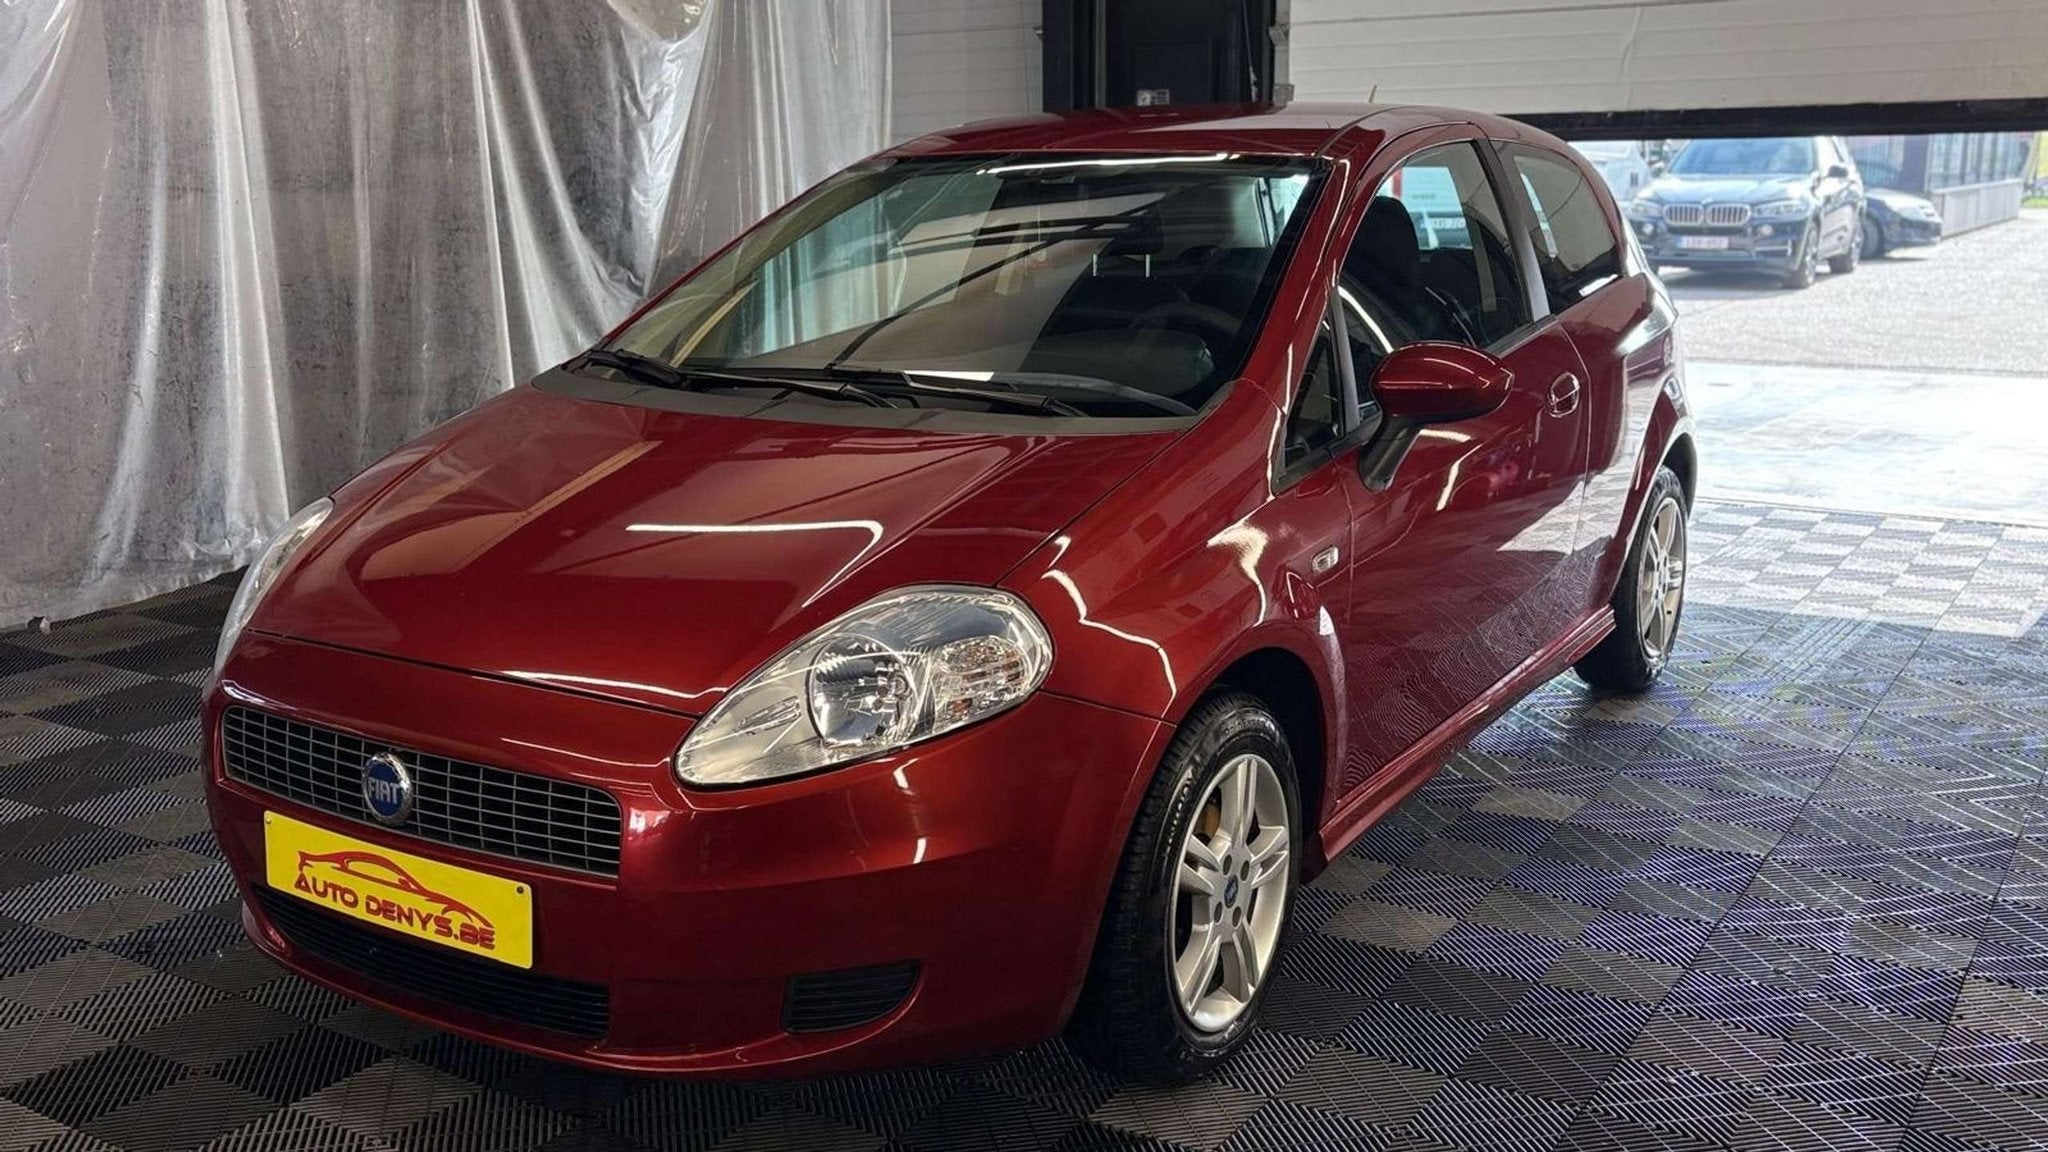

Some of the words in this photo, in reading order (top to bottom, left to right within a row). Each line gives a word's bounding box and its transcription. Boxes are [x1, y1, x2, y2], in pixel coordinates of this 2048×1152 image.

[368, 776, 400, 804] FIAT
[294, 872, 359, 909] AUTO
[365, 895, 496, 950] DENYS.BE
